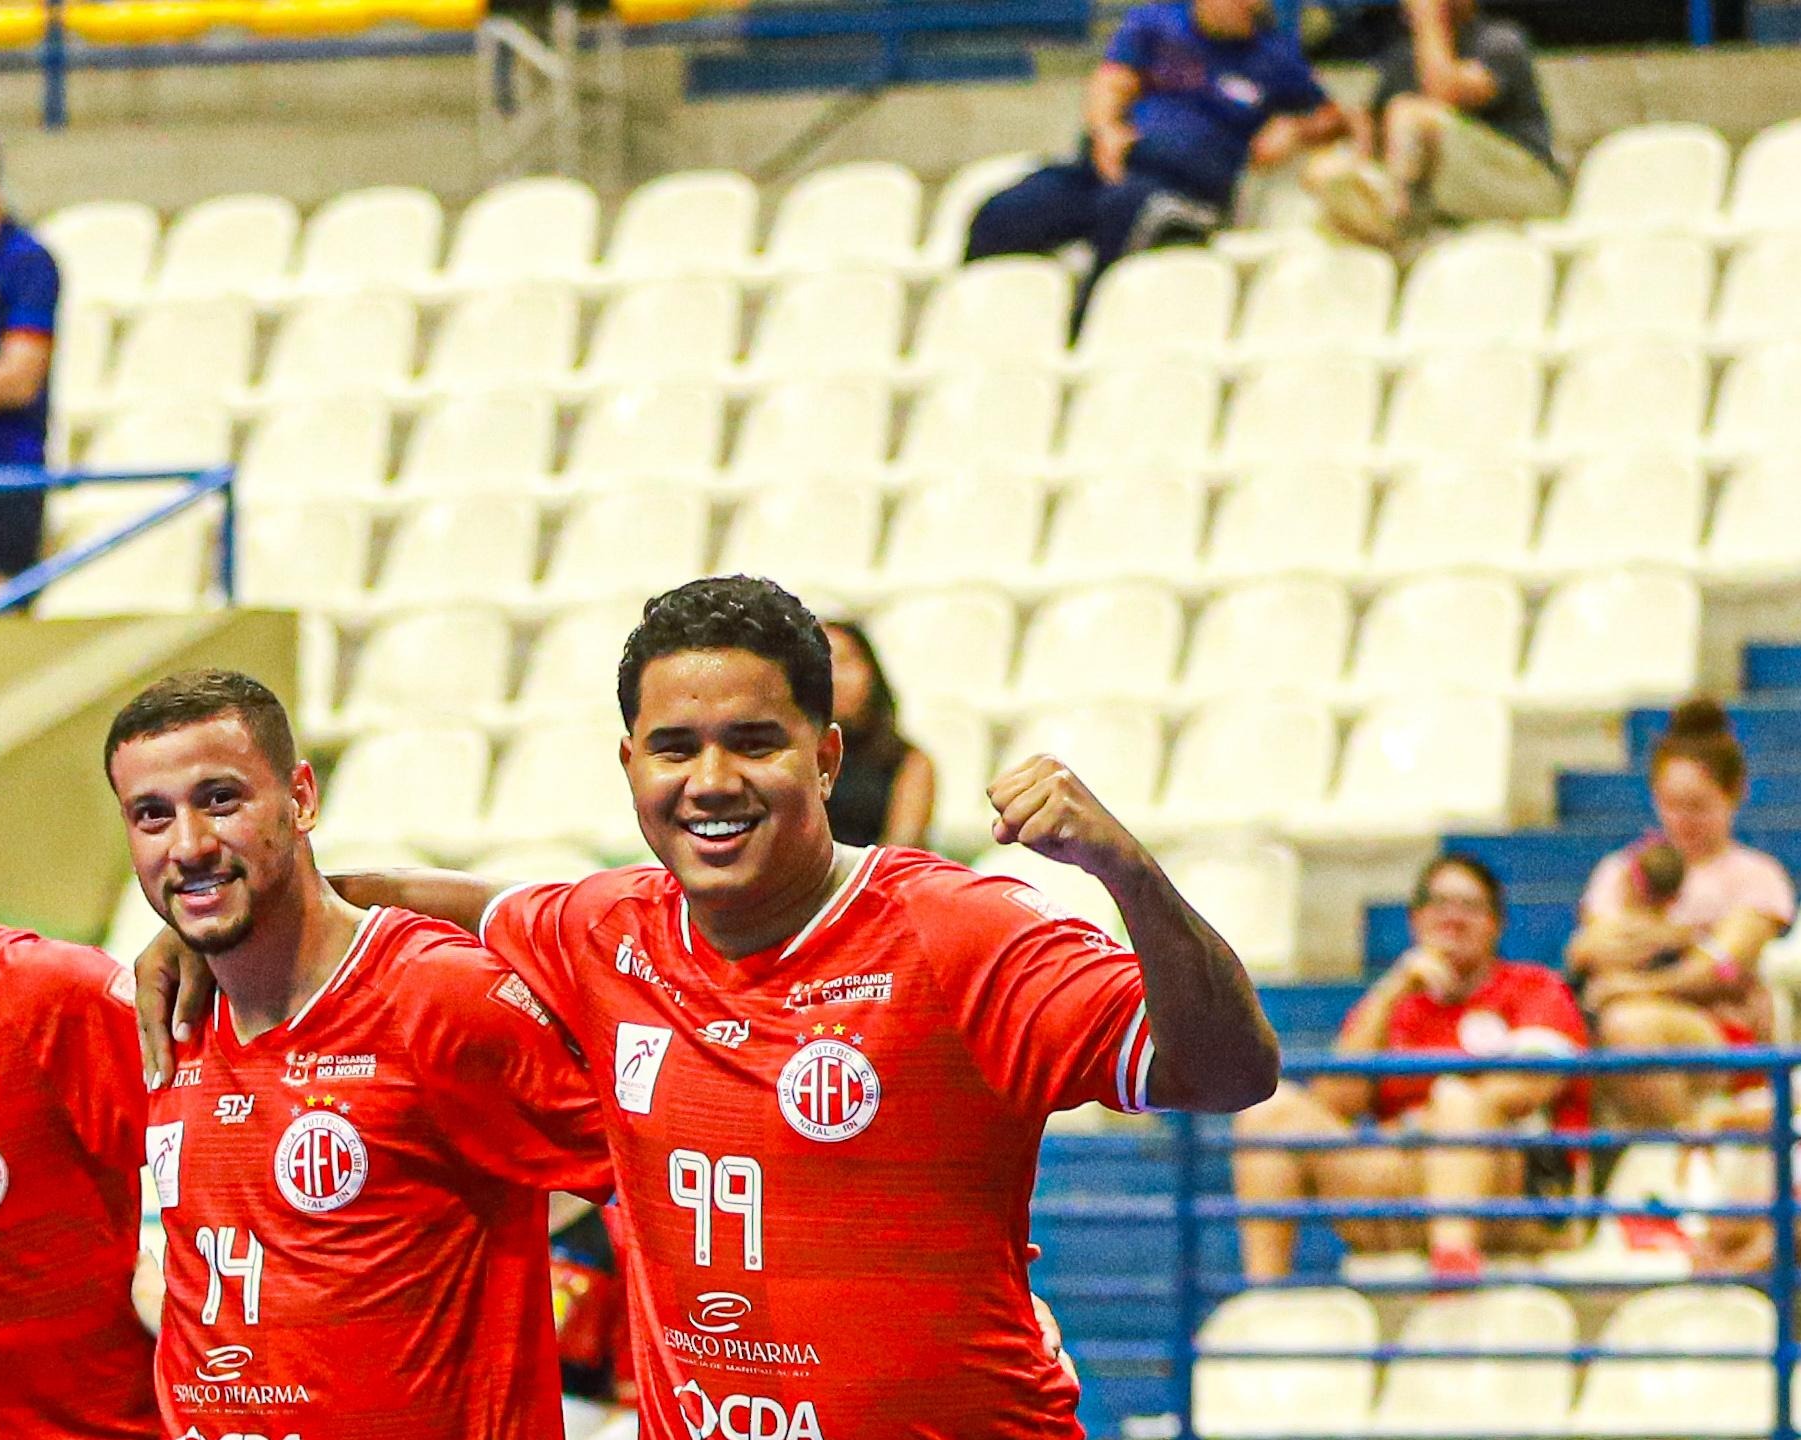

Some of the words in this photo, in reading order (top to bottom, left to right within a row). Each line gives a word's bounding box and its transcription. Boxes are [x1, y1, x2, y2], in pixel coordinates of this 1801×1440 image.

[844, 973, 894, 986] GRANDE
[821, 989, 843, 1001] DO
[845, 985, 892, 1000] NORTE
[696, 1019, 750, 1042] STY
[316, 1065, 333, 1077] DO
[334, 1064, 376, 1076] NORTE
[335, 1053, 377, 1065] GRANDE
[171, 1067, 203, 1089] ATAL
[860, 1070, 875, 1106] CLUBE
[792, 1057, 861, 1125] AFC
[213, 1093, 256, 1118] STY
[796, 1118, 831, 1137] NATAL
[289, 1127, 350, 1197] AFC
[667, 1149, 763, 1271] 99
[196, 1226, 265, 1326] 14
[723, 1338, 821, 1365] PHARMA
[223, 1384, 310, 1405] PHARMA
